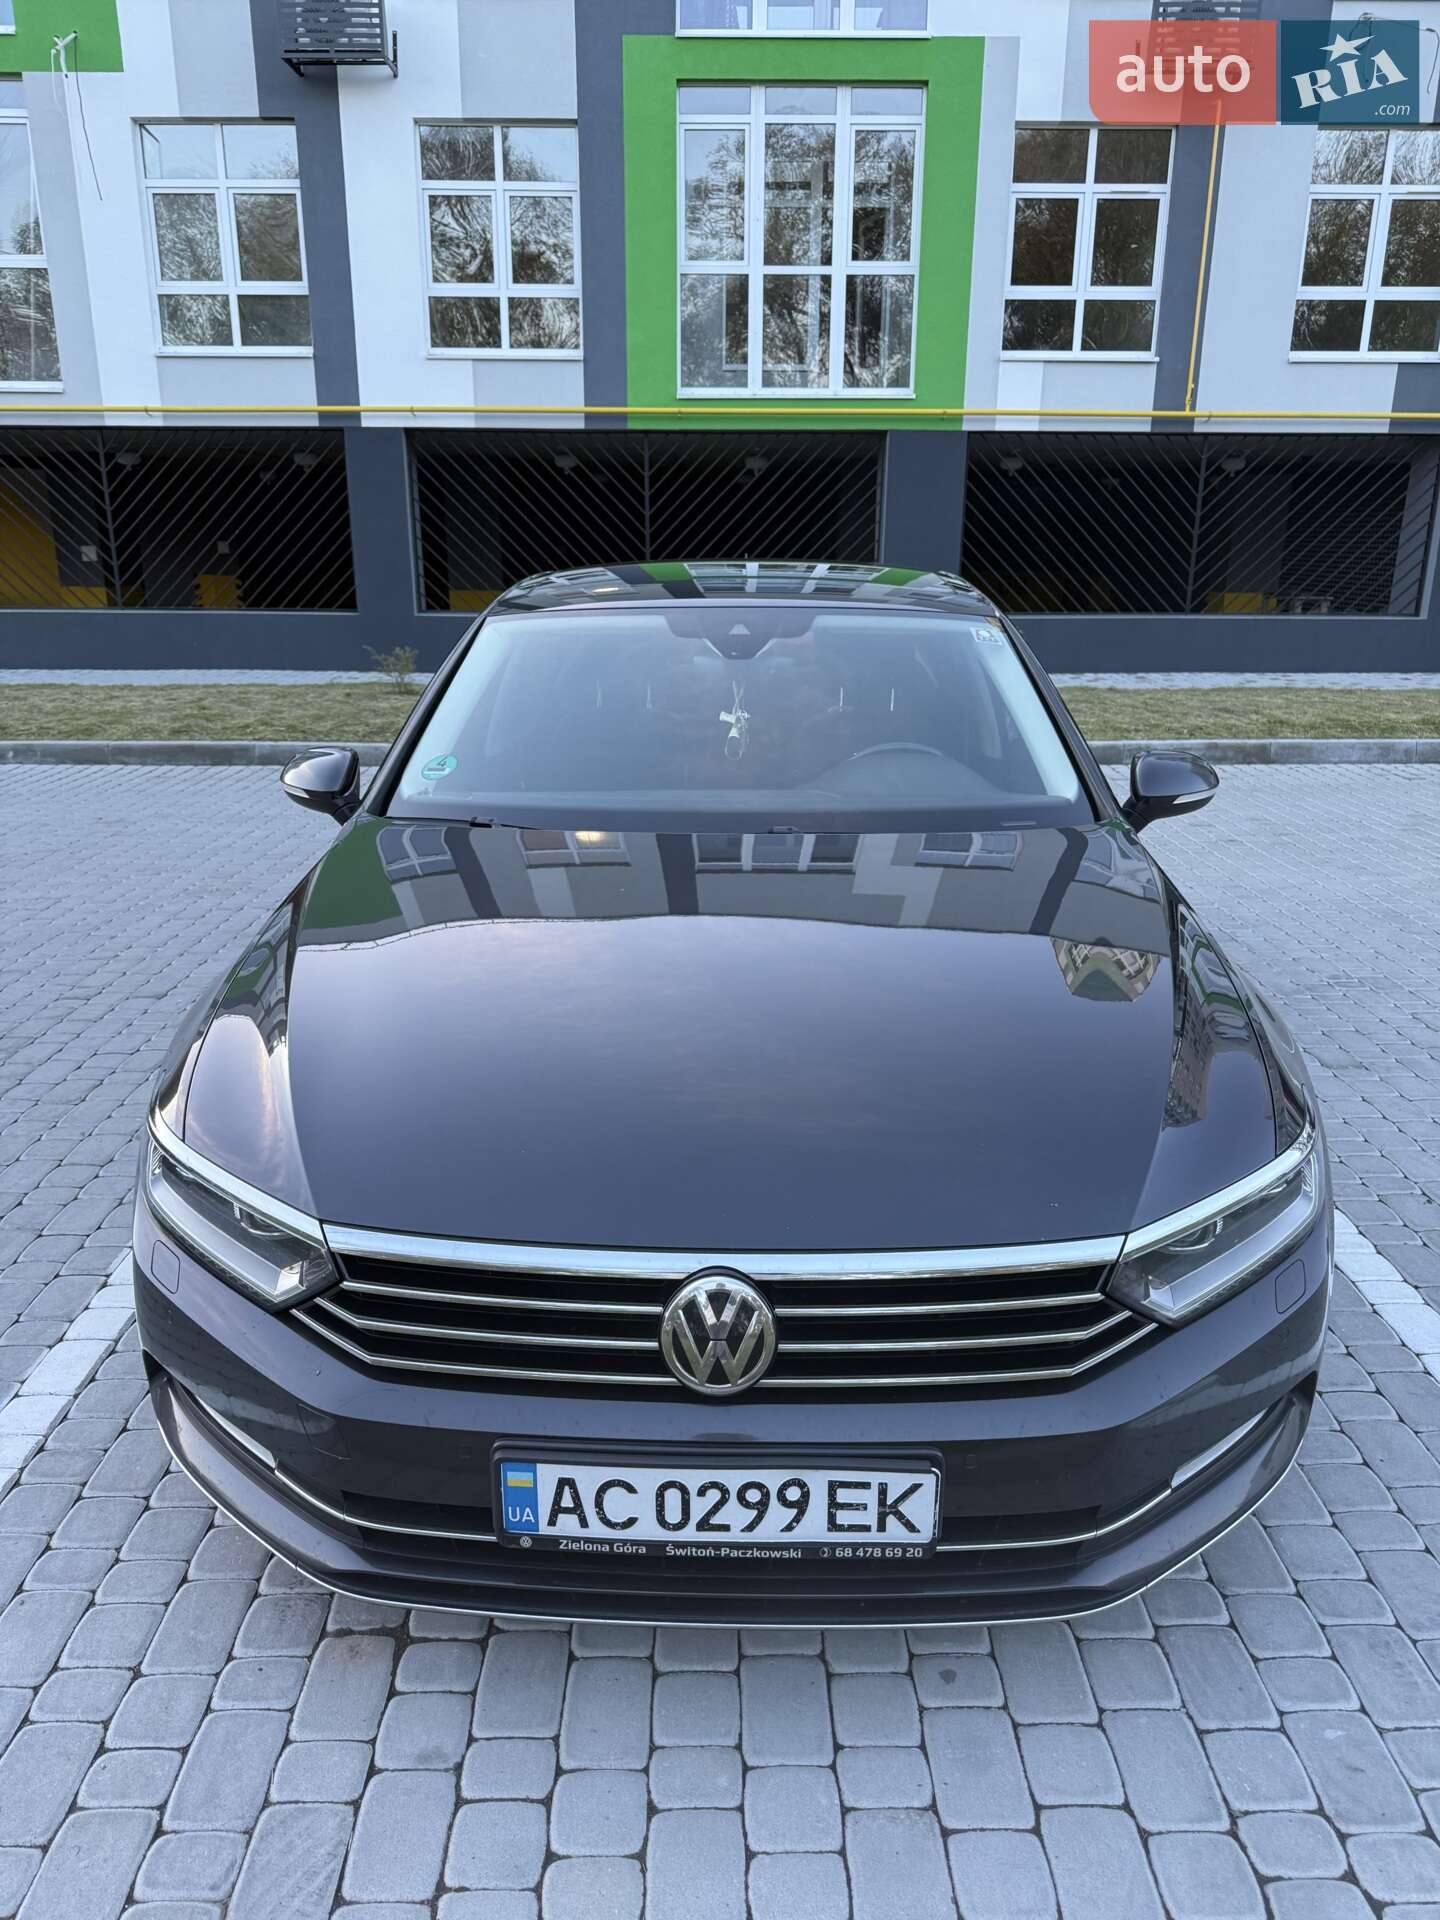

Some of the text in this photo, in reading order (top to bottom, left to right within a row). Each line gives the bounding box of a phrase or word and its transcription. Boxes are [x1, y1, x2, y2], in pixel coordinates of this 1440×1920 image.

[655, 1477, 811, 1533] 0299
[508, 1506, 535, 1524] UA
[559, 1539, 923, 1558] Zielona Góra Świtoń-Paczkowski 68 478 69 20
